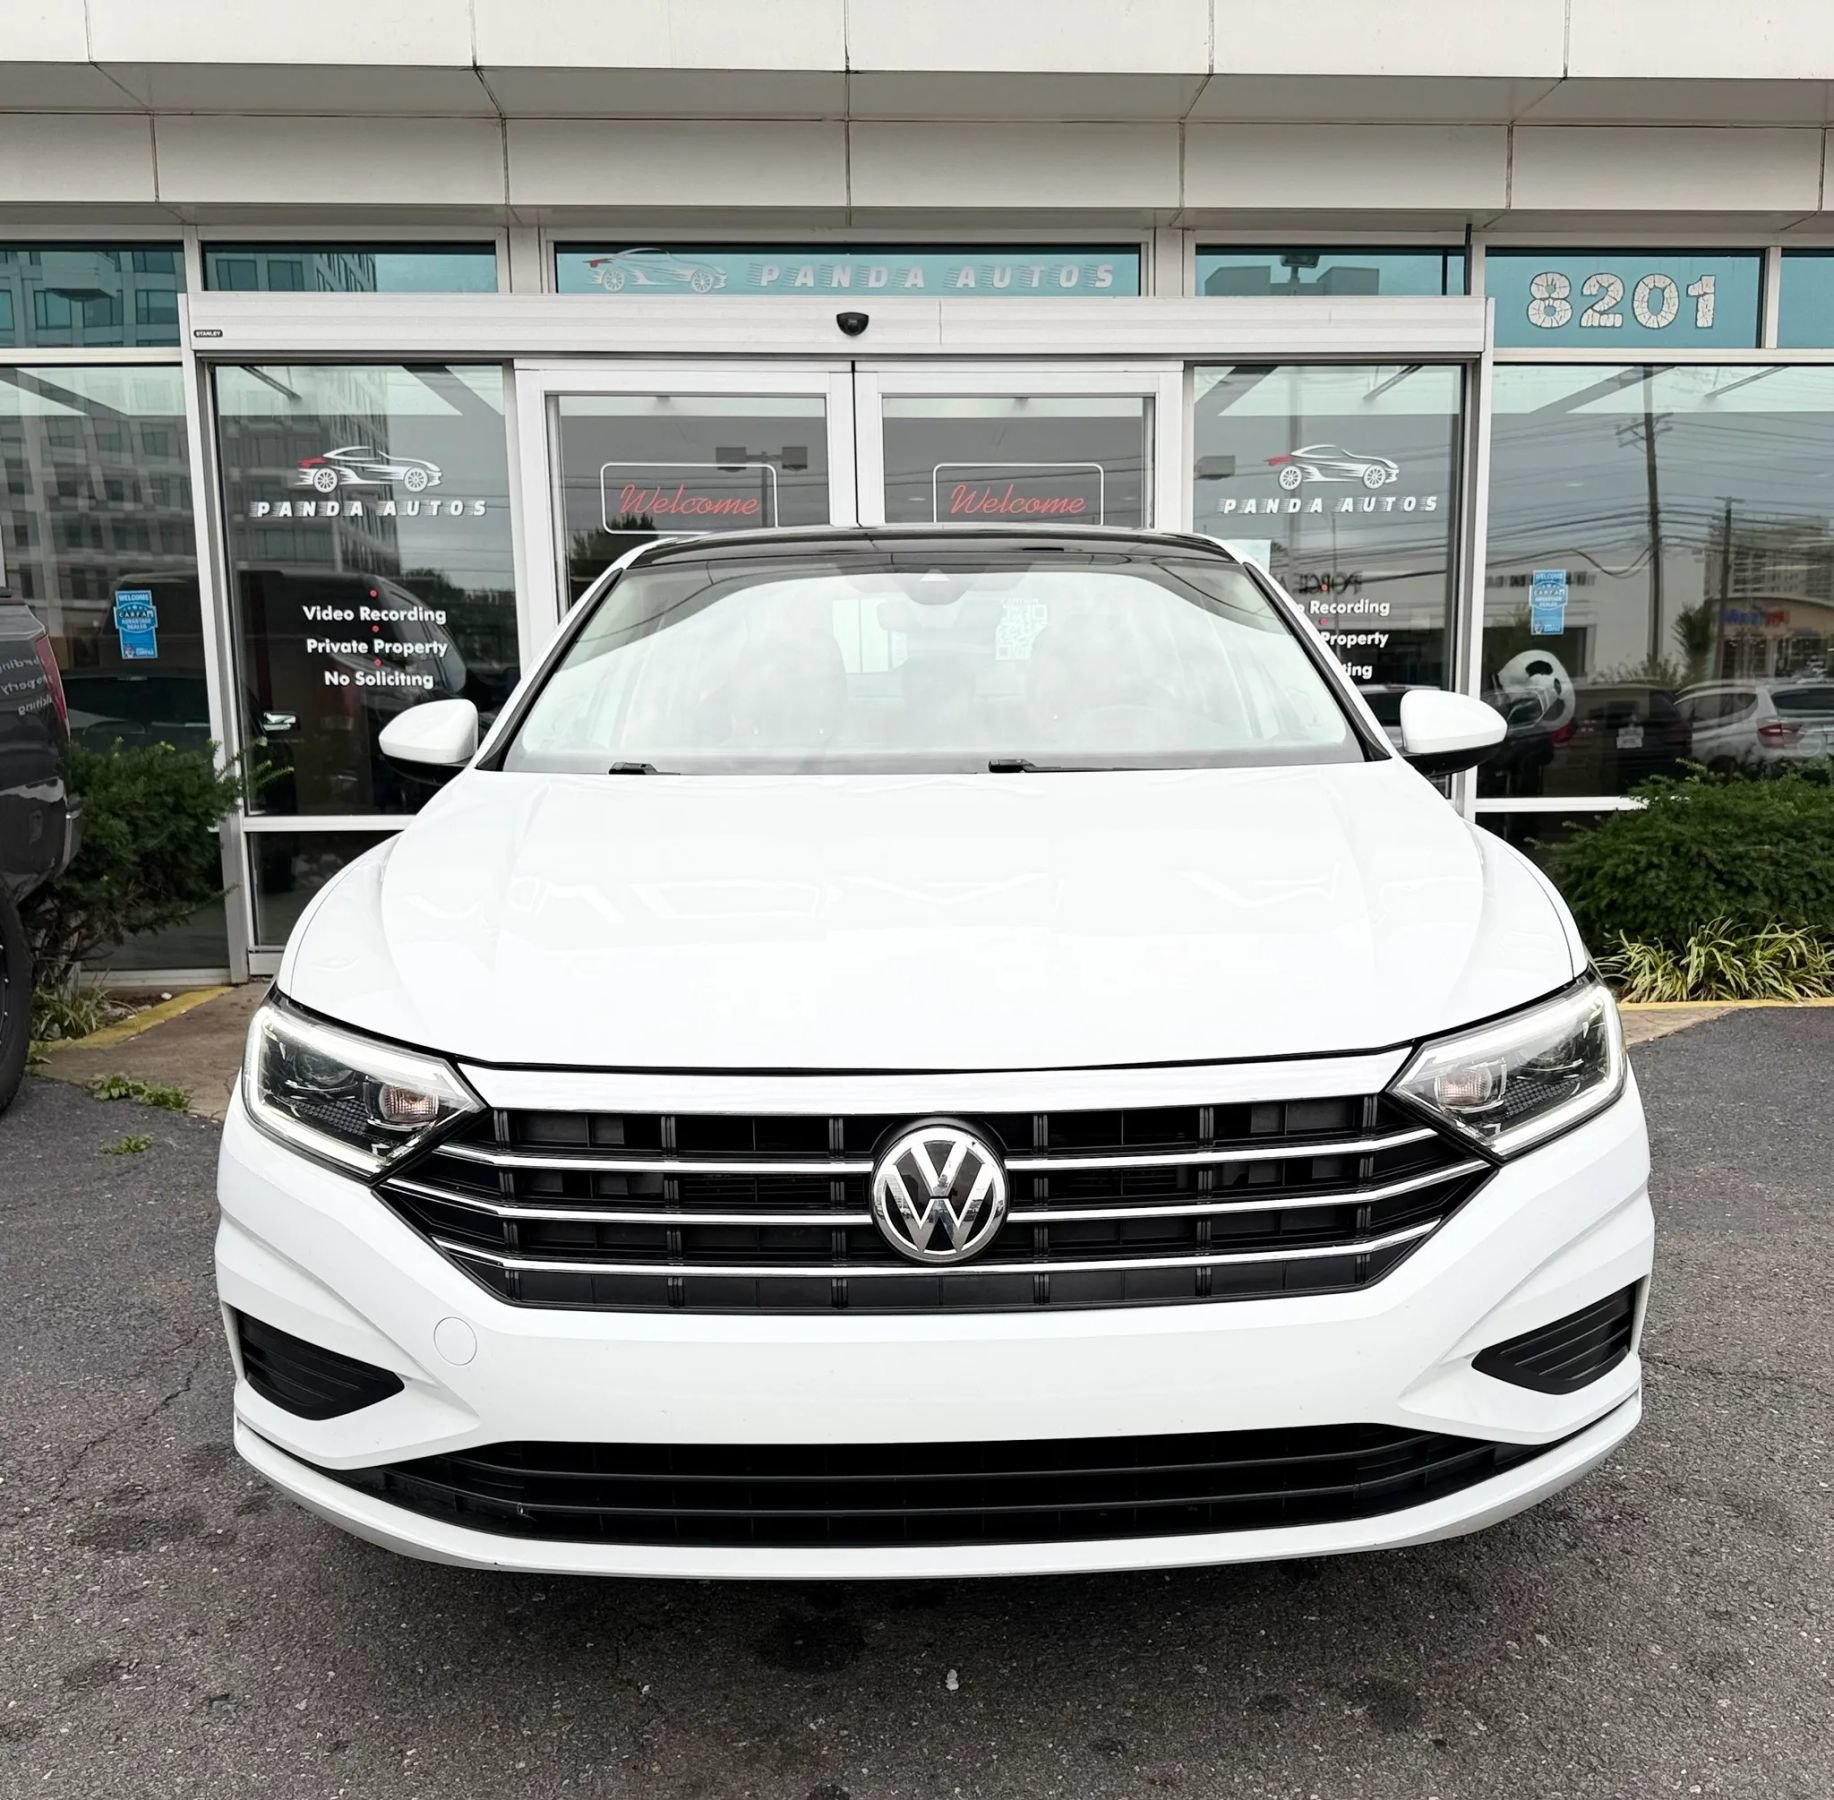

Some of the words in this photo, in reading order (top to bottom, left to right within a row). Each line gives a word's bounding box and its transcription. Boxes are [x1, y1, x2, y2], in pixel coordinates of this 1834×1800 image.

[752, 263, 925, 289] PANDA
[945, 263, 1114, 289] AUTOS
[1526, 271, 1716, 329] 8201
[250, 501, 364, 518] PANDA
[378, 500, 488, 517] AUTOS
[619, 483, 761, 517] Welcome
[950, 484, 1088, 516] Welcome
[1218, 498, 1323, 515] PANDA
[1336, 496, 1438, 513] AUTOS
[303, 605, 354, 622] Video
[359, 606, 447, 626] Recording
[1310, 599, 1390, 616] Recording
[306, 639, 369, 654] Private
[374, 639, 448, 657] Property
[1320, 631, 1389, 648] Property
[324, 671, 351, 686] No
[353, 671, 434, 689] Soliciting
[873, 1127, 1006, 1263] VW
